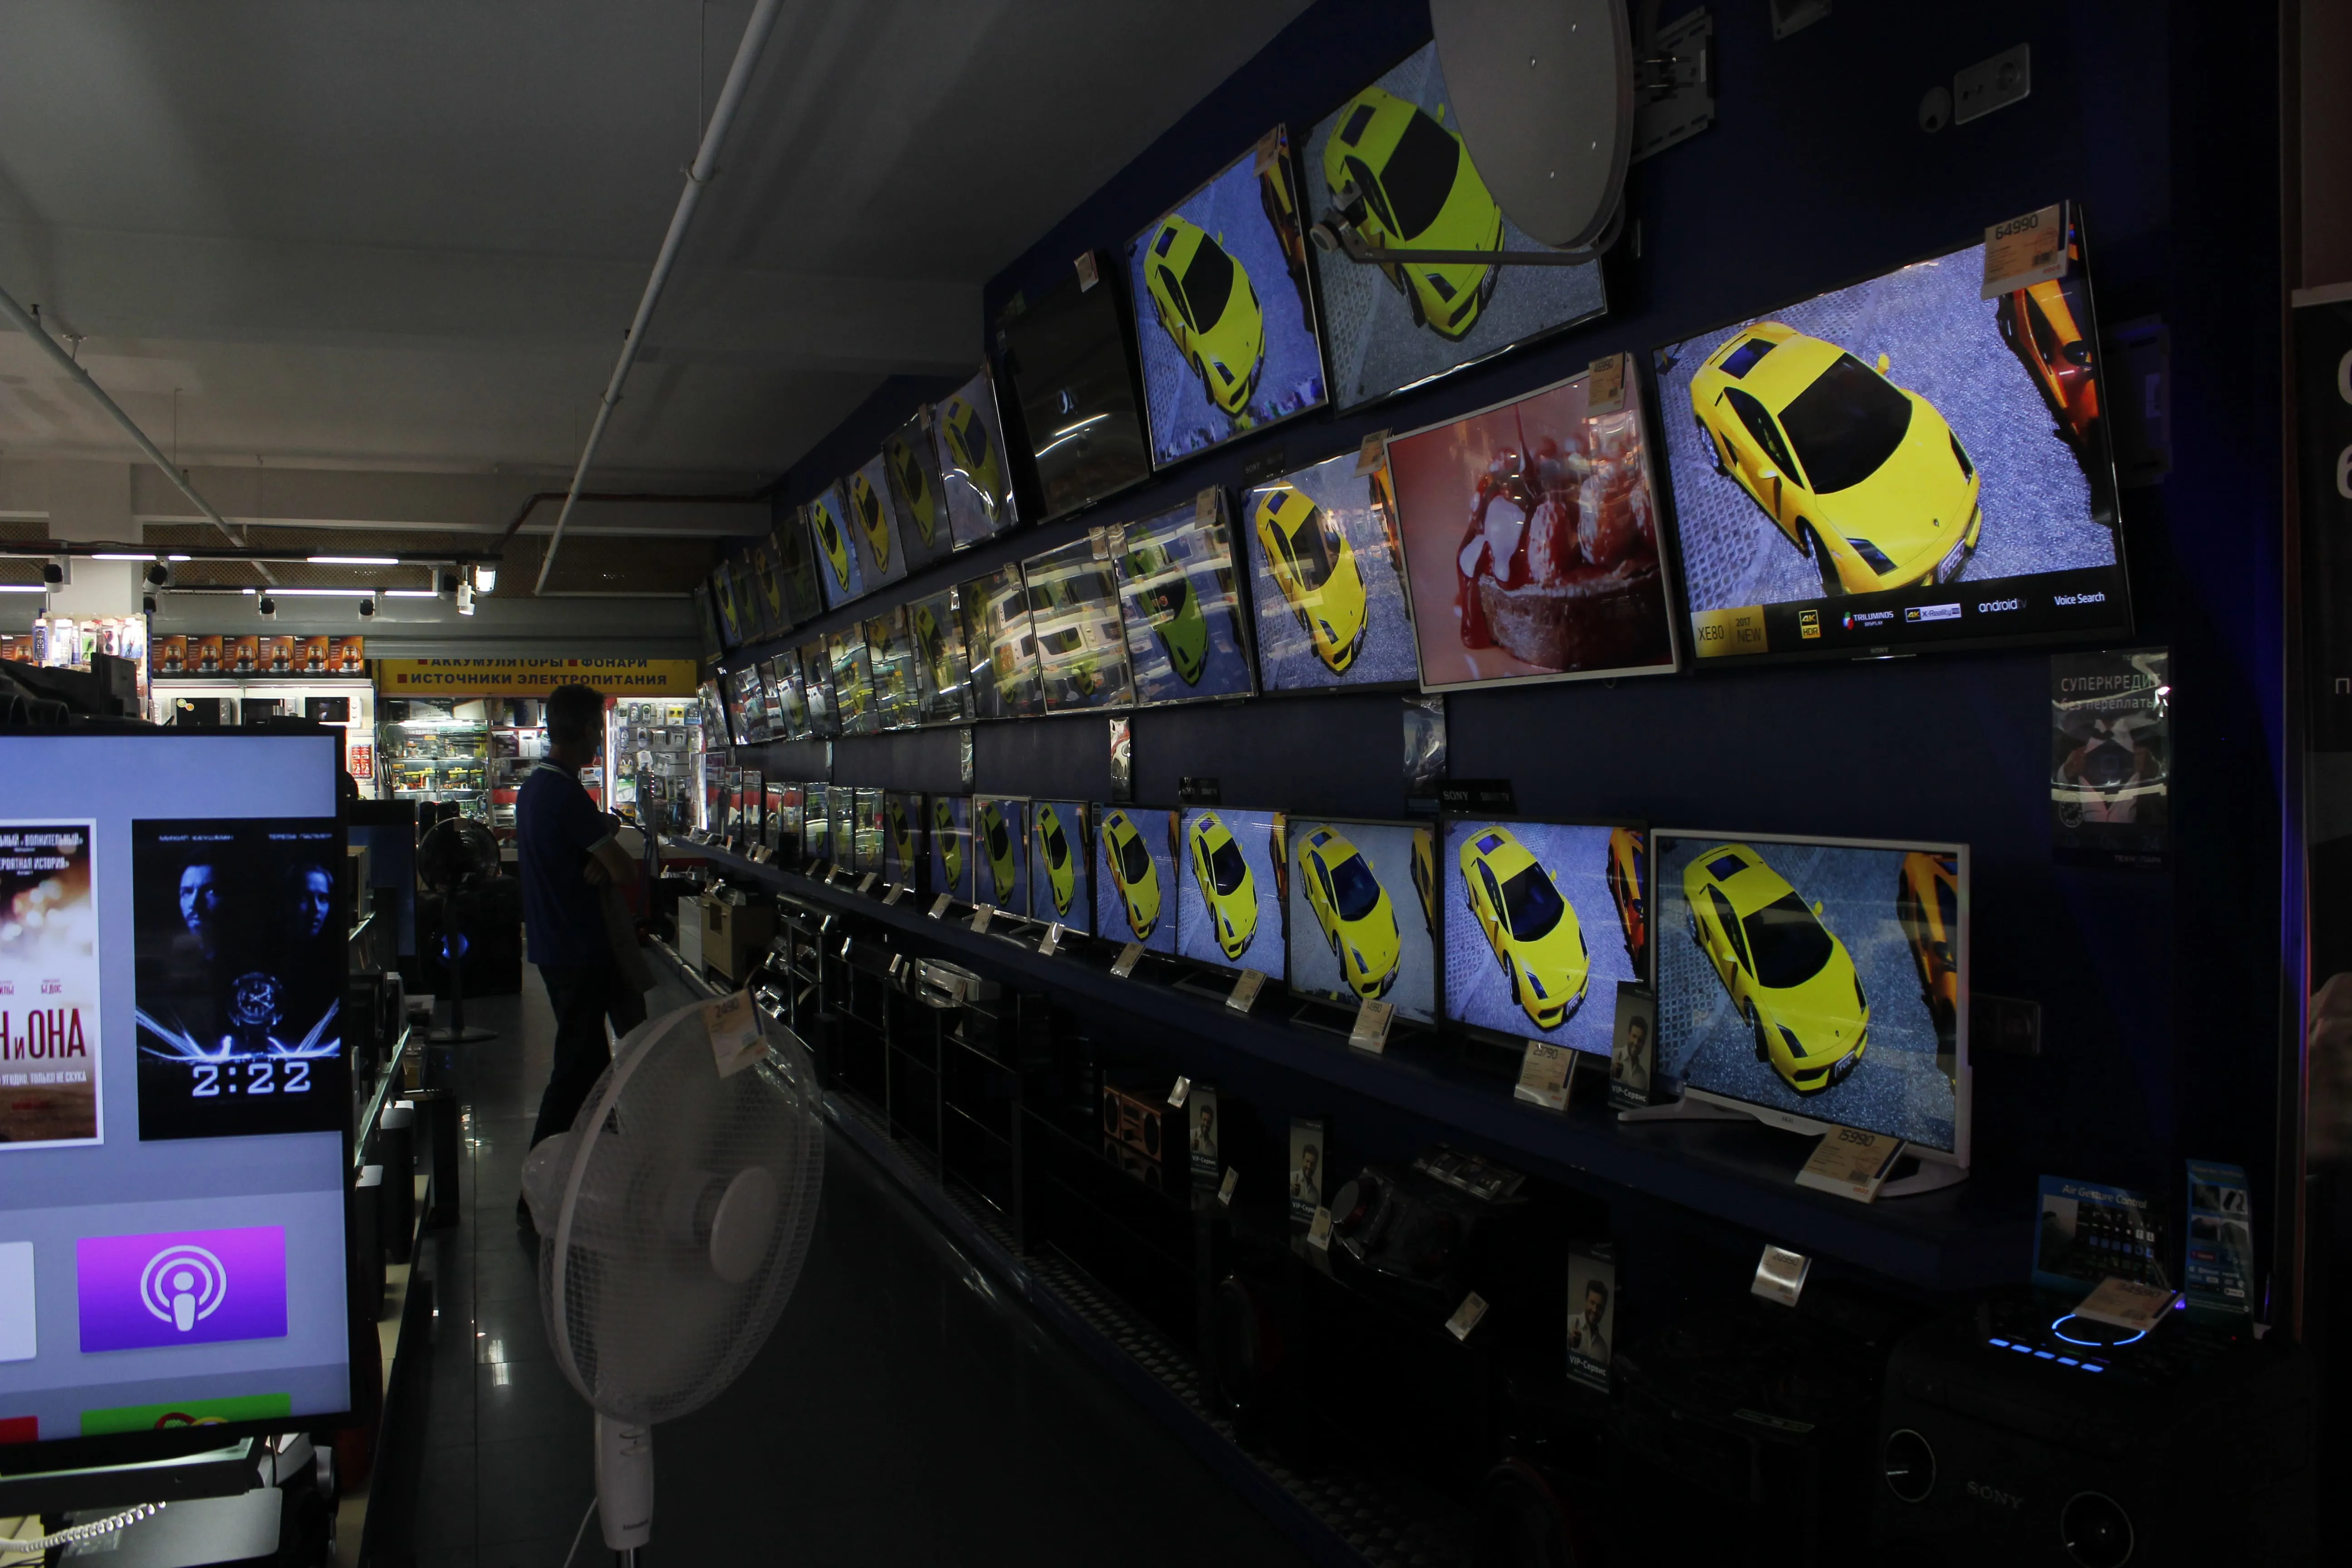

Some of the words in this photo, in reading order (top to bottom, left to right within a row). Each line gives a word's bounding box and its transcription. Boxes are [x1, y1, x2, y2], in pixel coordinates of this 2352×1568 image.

[1996, 214, 2038, 240] 64990
[2054, 595, 2077, 606] Voice
[2077, 592, 2105, 603] Search
[1853, 611, 1894, 621] TRILUMINOS
[1921, 608, 1952, 617] X-Reality
[1735, 617, 1751, 627] 2017
[1698, 625, 1725, 642] XE80
[1737, 628, 1761, 642] NEW
[1803, 627, 1819, 636] HDR
[431, 659, 563, 667] АККУМУЛЯТОРЫ
[581, 659, 647, 668] ФОНАРИ
[411, 674, 512, 684] ИСТОЧНИКИ
[517, 674, 666, 685] ЭЛЕКТРОПИТАНИЯ
[1443, 790, 1468, 801] SONY
[29, 1009, 87, 1059] ОНА
[192, 1061, 311, 1097] 2:22
[1612, 1084, 1646, 1102] VIP-Сервис
[1838, 1128, 1875, 1147] 15990
[1192, 1156, 1216, 1166] VIP-Сервис
[2062, 1185, 2077, 1194] Air
[2078, 1187, 2114, 1202] Gesture
[2116, 1194, 2148, 1209] Control
[1570, 1354, 1607, 1376] VIP-Сервис
[1966, 1480, 2024, 1509] SONY
